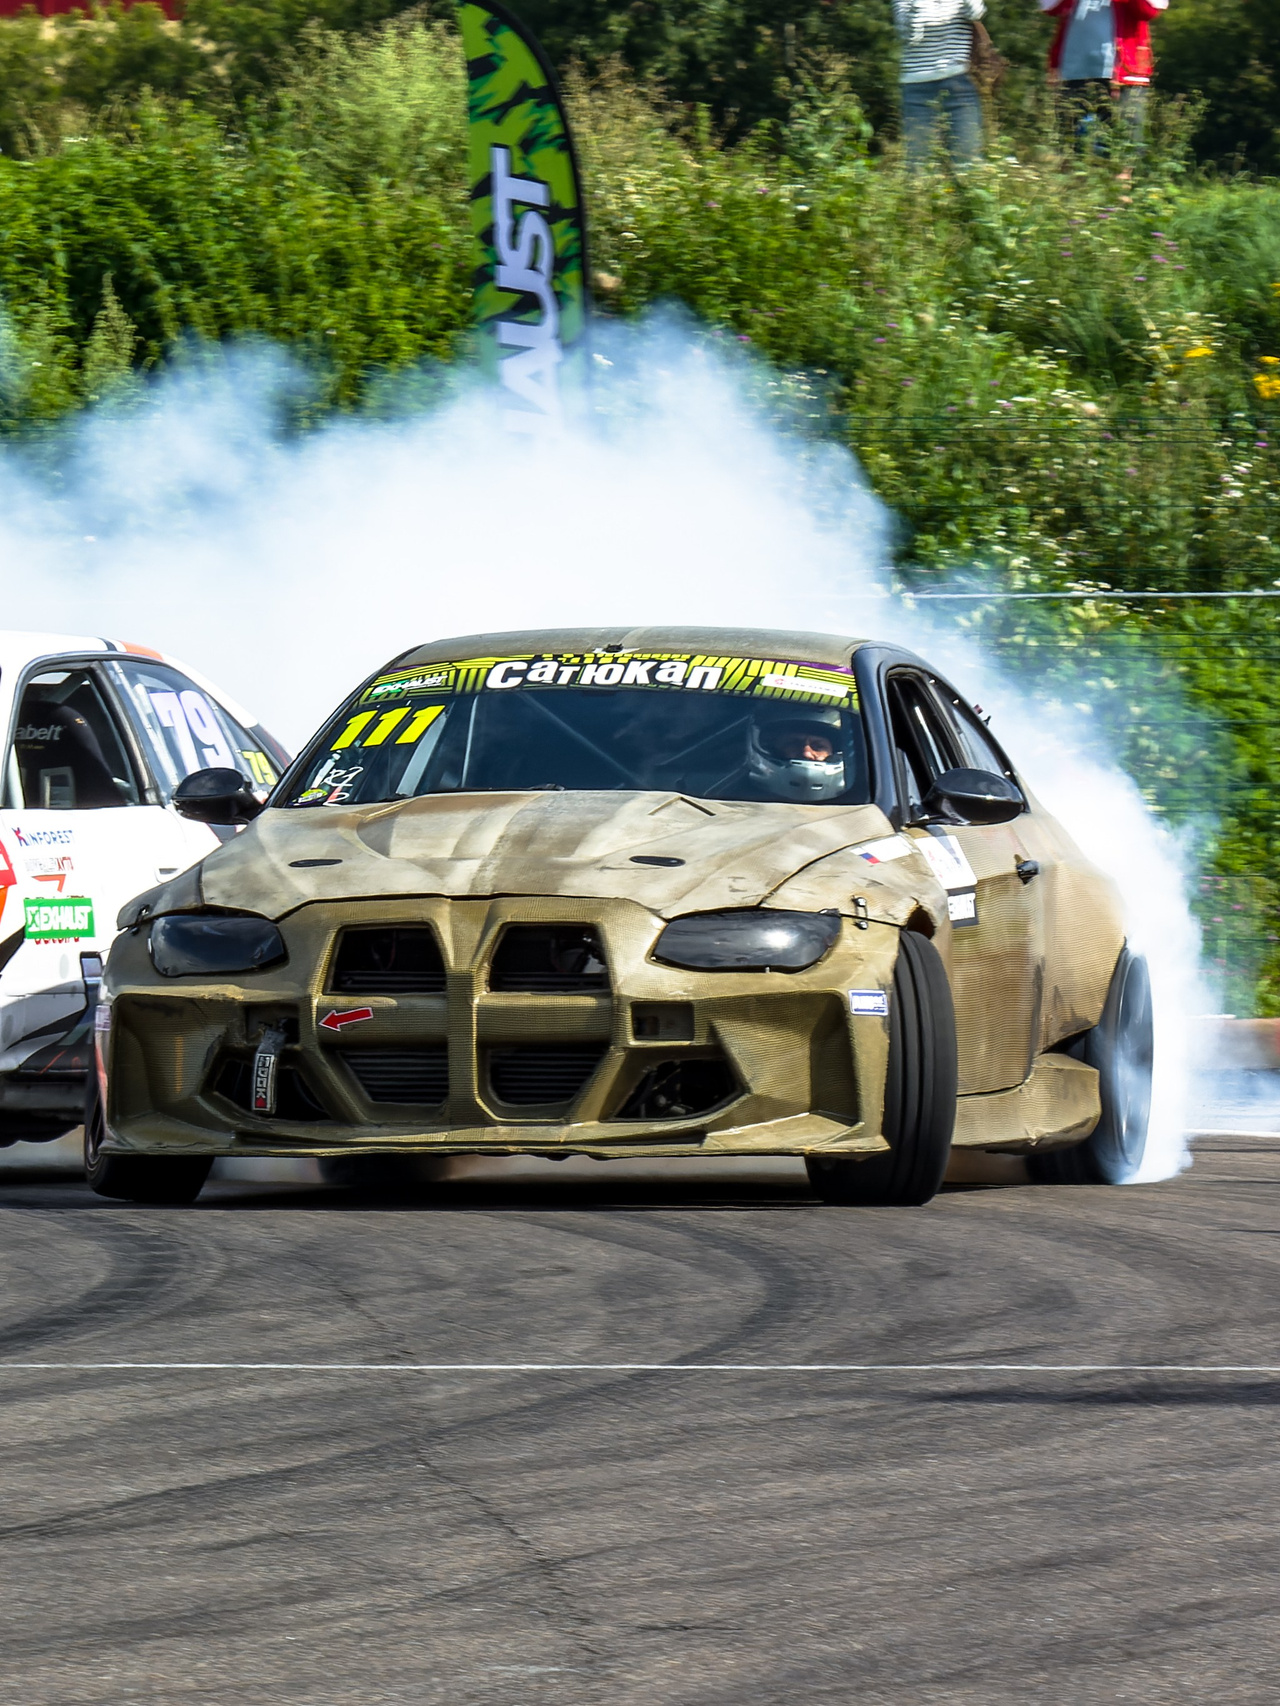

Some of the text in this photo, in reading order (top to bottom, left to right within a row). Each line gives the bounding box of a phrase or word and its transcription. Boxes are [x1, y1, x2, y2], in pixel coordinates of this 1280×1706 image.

[15, 724, 63, 740] abelt
[148, 689, 236, 778] 79
[329, 705, 446, 751] 111
[242, 750, 278, 786] 79
